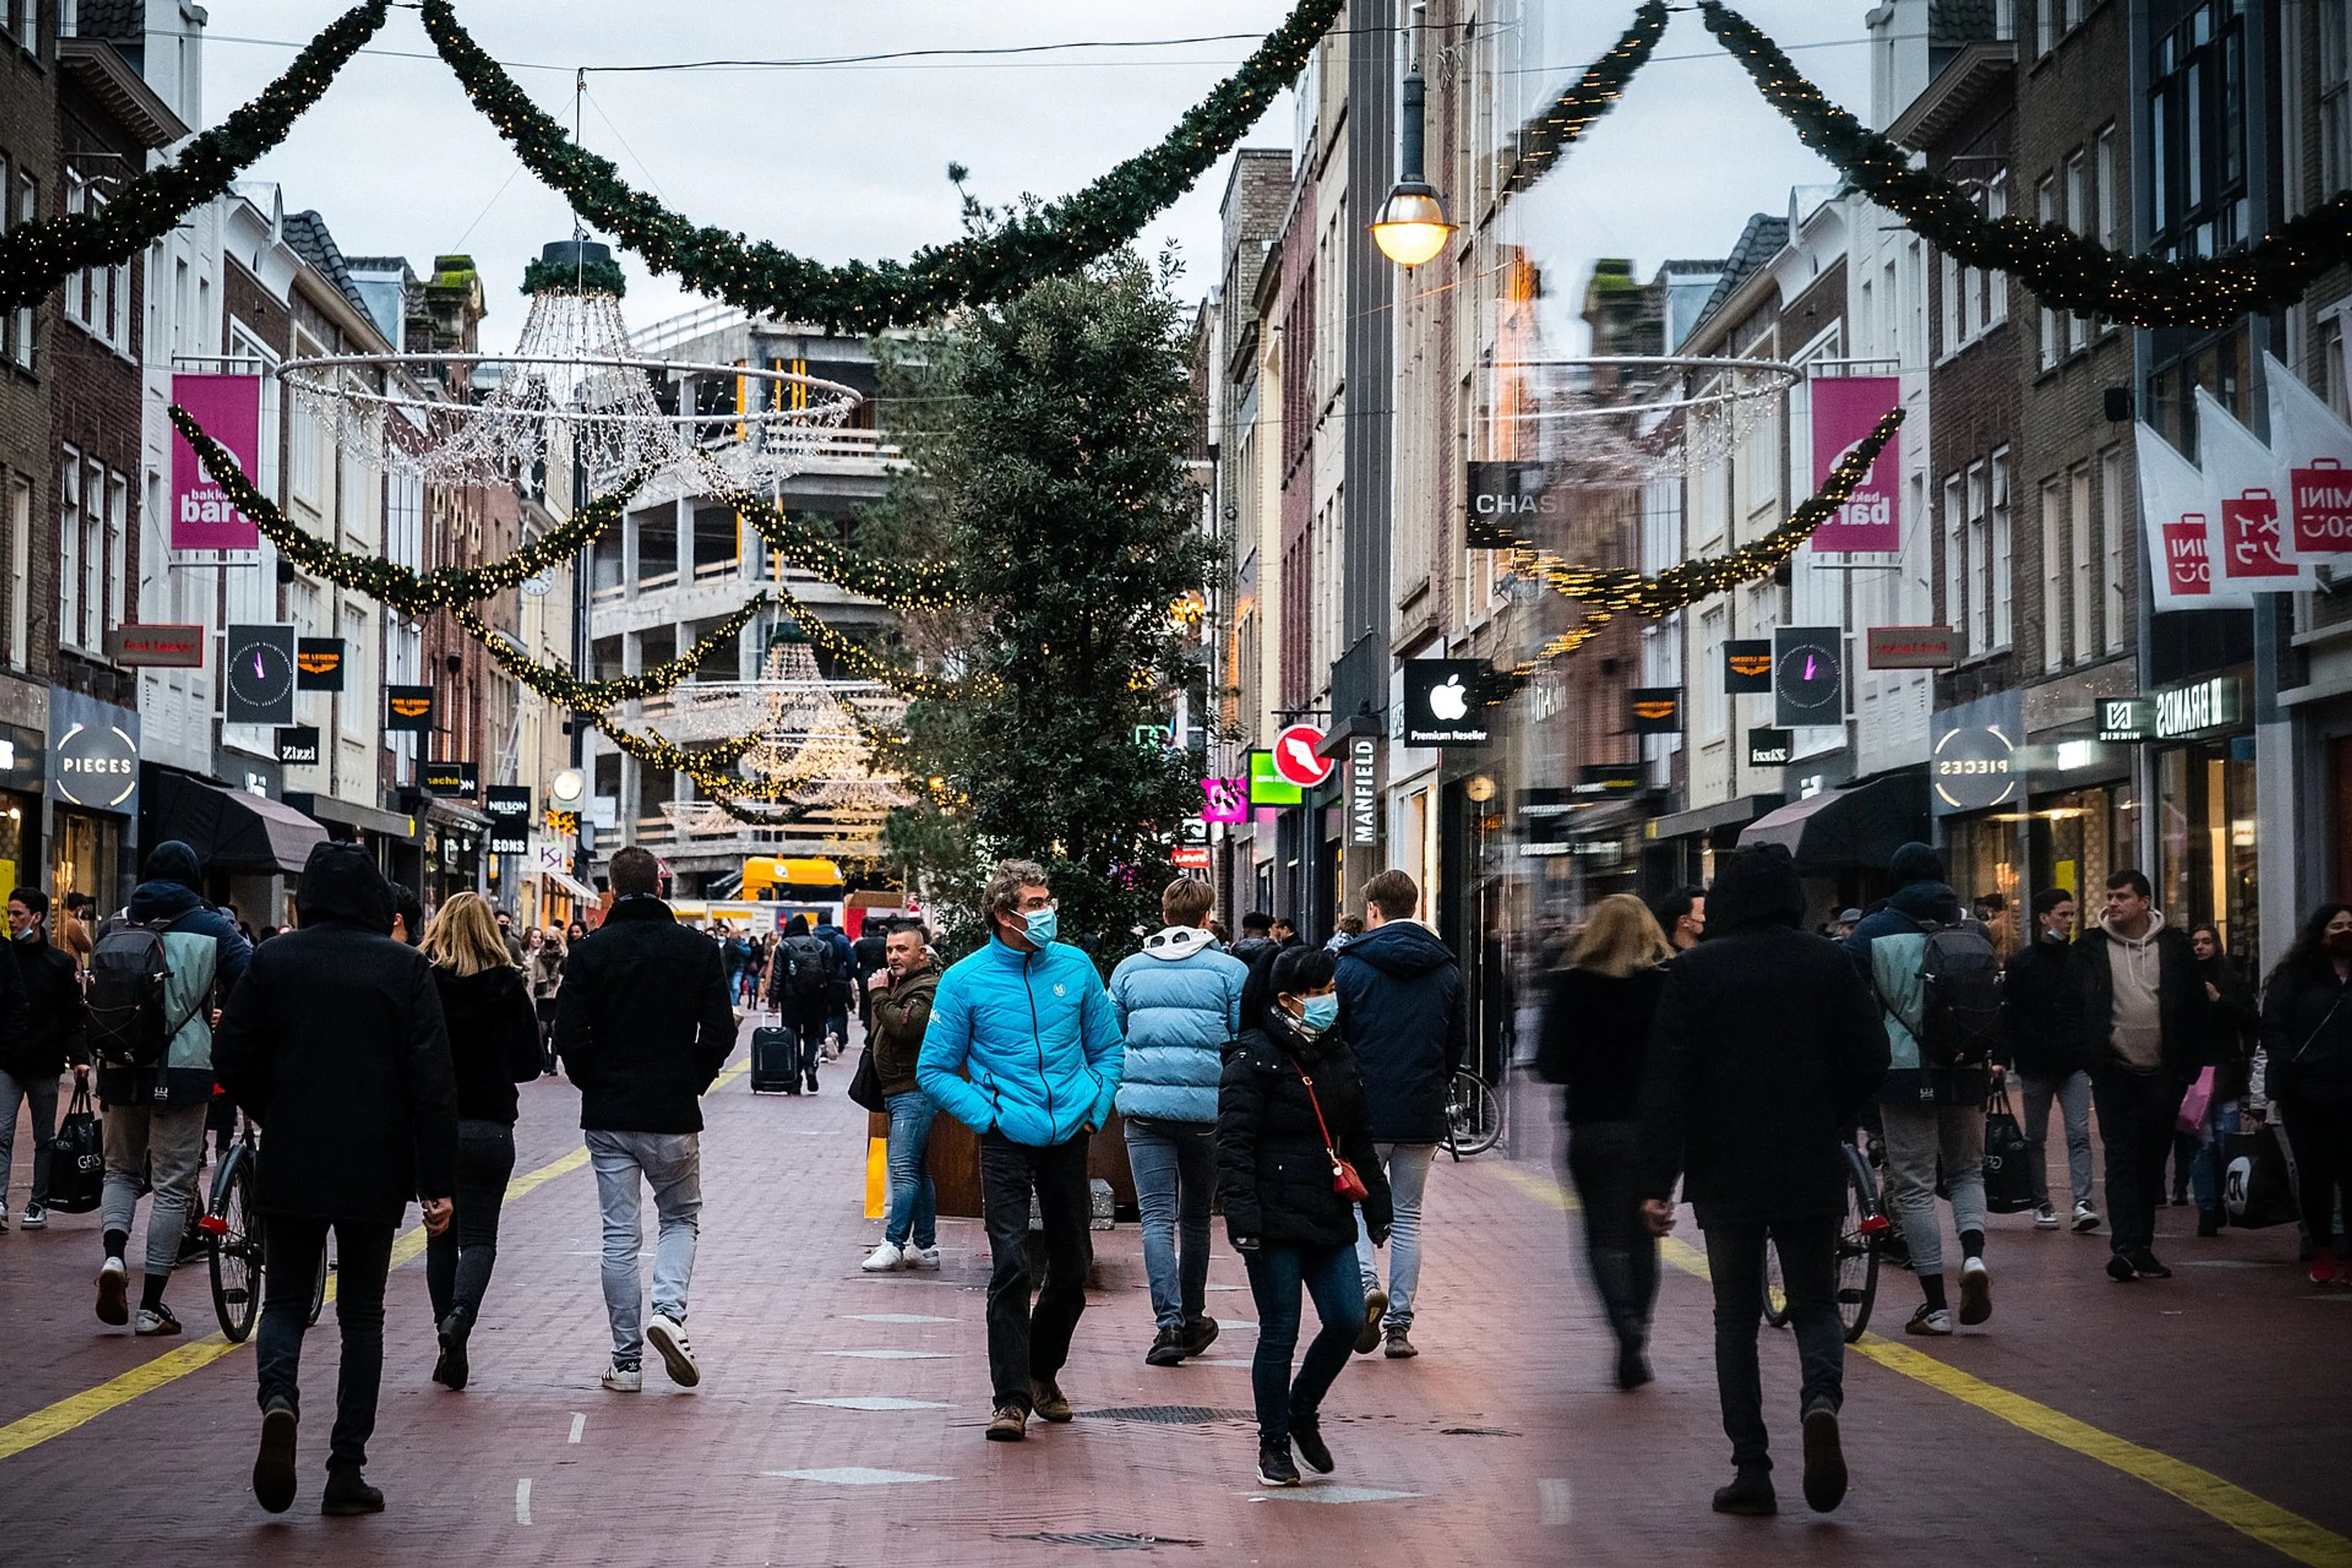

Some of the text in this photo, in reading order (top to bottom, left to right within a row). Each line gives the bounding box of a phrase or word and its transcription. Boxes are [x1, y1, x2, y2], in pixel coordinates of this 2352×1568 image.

[1411, 730, 1487, 741] Premium Reseller
[63, 758, 131, 774] PIECES
[1355, 741, 1374, 842] MANFIELD
[489, 801, 527, 812] NELSON
[492, 839, 525, 853] SONS
